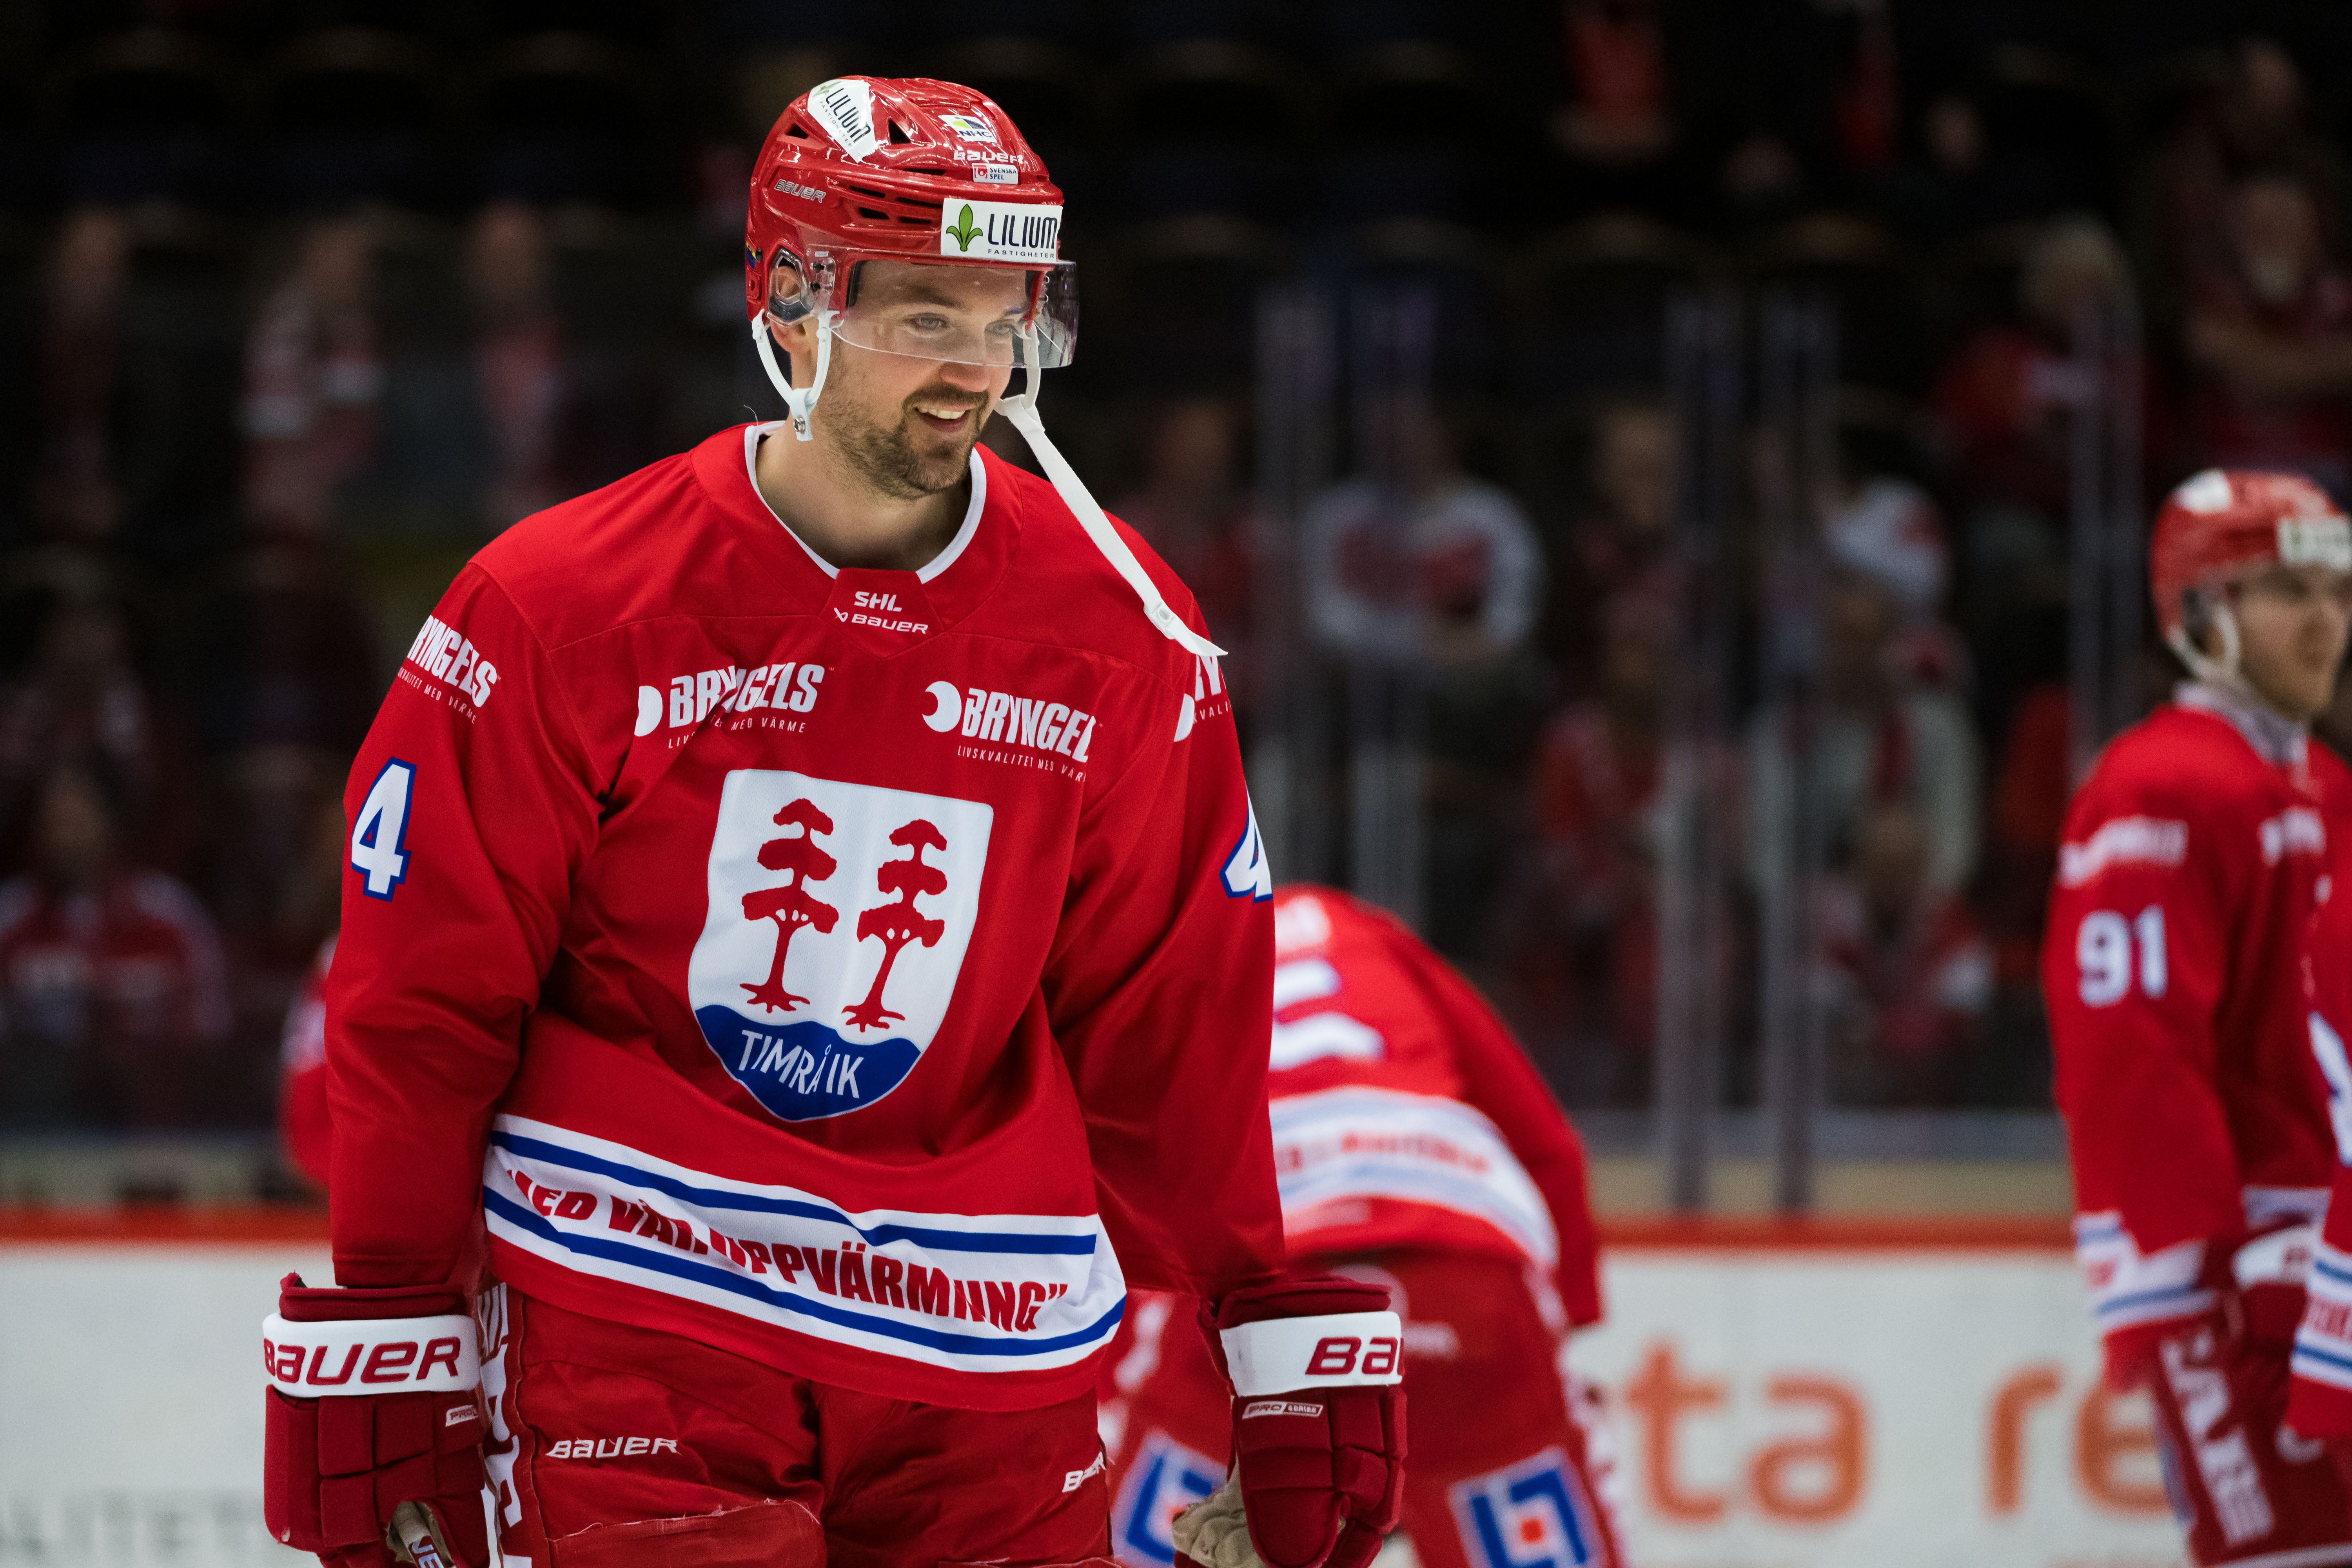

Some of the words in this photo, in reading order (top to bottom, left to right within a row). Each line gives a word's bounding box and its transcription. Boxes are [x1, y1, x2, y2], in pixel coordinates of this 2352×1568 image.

[820, 101, 852, 147] FASTIGHETER
[988, 214, 1058, 249] LILIUM
[988, 249, 1054, 258] FASTIGHETER
[854, 591, 902, 612] SHL
[424, 684, 442, 701] MED
[448, 696, 476, 724] VÄRME
[731, 718, 752, 731] MED
[762, 717, 806, 733] VÄRME
[962, 688, 1096, 763] BRYNGEL
[957, 745, 1033, 767] LIVSKVALITET
[1038, 759, 1054, 771] MED
[351, 756, 417, 902] 4
[2077, 904, 2168, 1009] 91
[738, 1029, 831, 1094] TIMRÅ
[826, 1053, 864, 1099] IK
